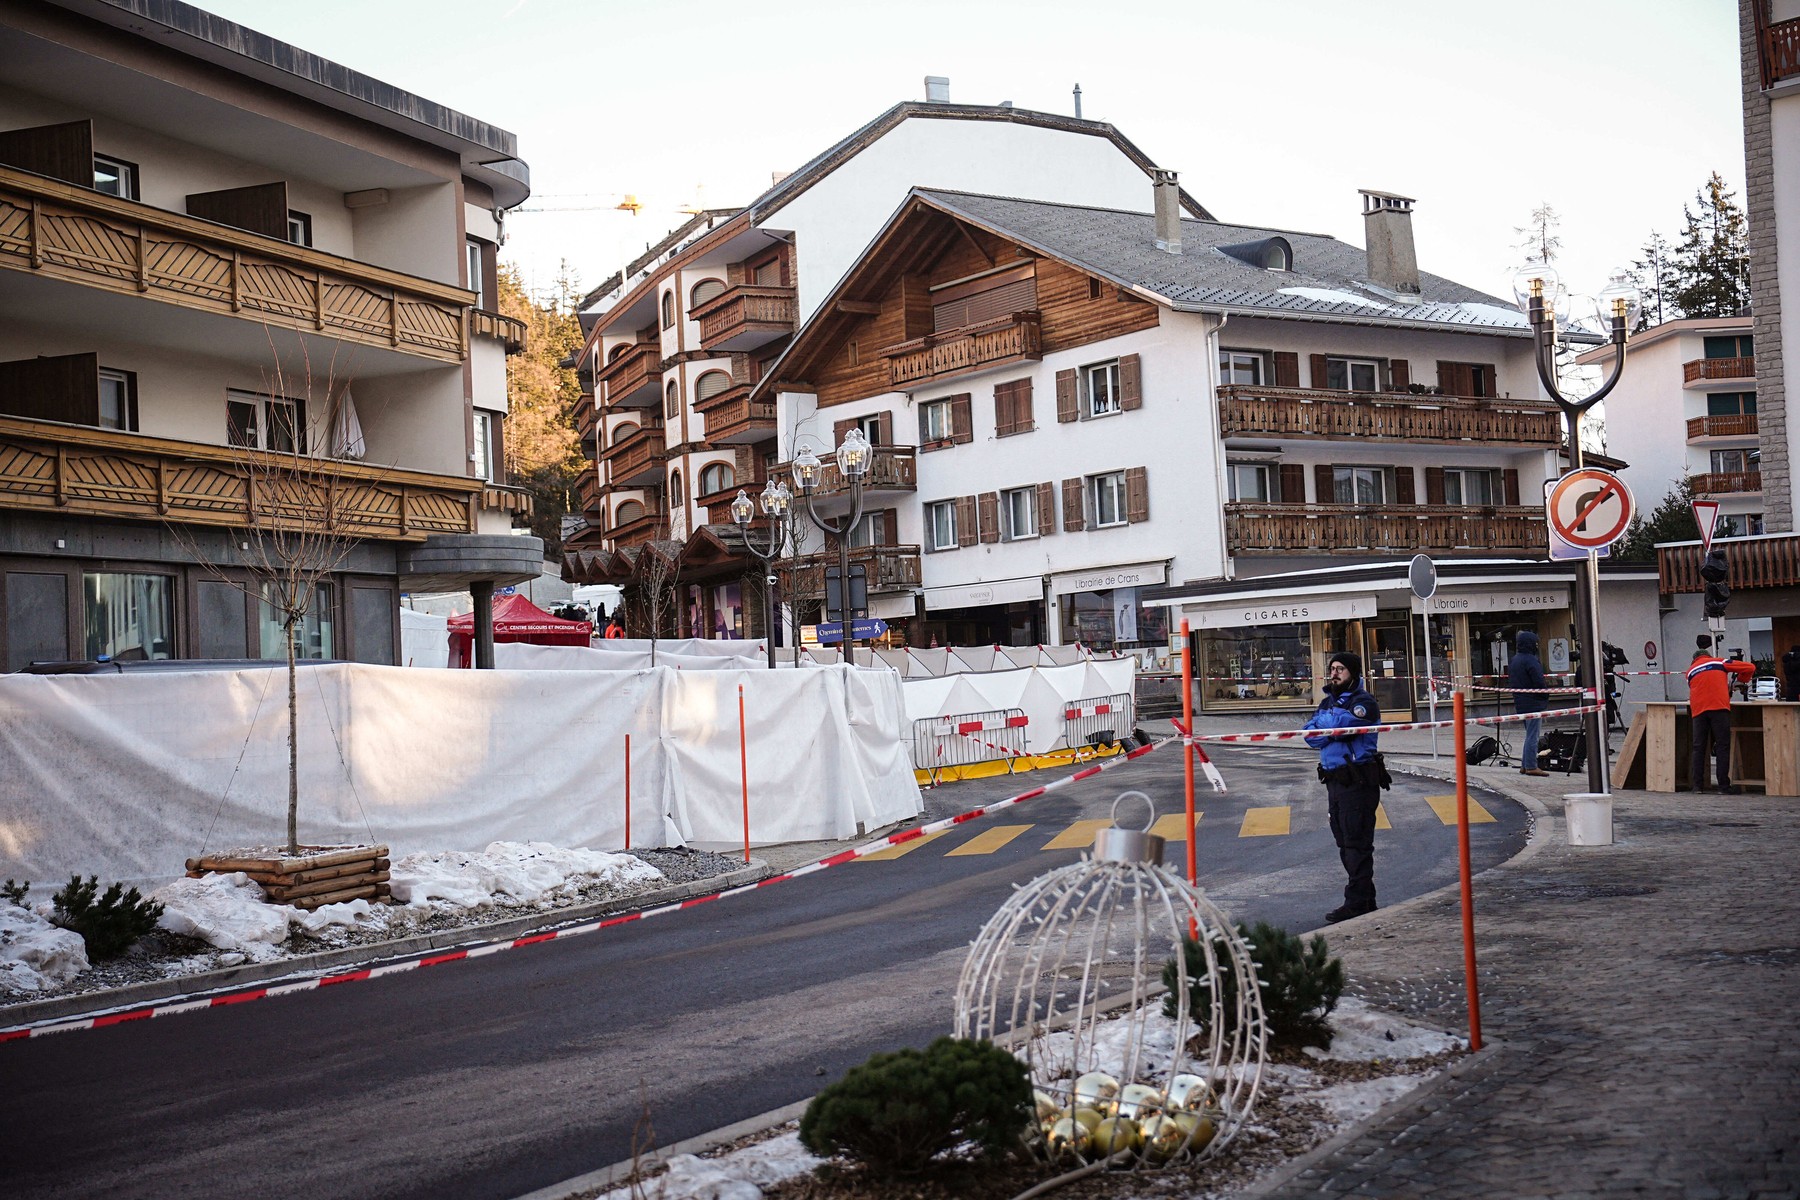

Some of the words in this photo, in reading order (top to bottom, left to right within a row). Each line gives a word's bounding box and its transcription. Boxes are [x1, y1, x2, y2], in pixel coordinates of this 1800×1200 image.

[1075, 578, 1103, 589] Librairie
[1105, 576, 1116, 586] de
[1117, 573, 1140, 584] Crans
[1433, 598, 1469, 610] Librairie
[1509, 595, 1556, 605] CIGARES
[1244, 607, 1309, 621] CIGARES
